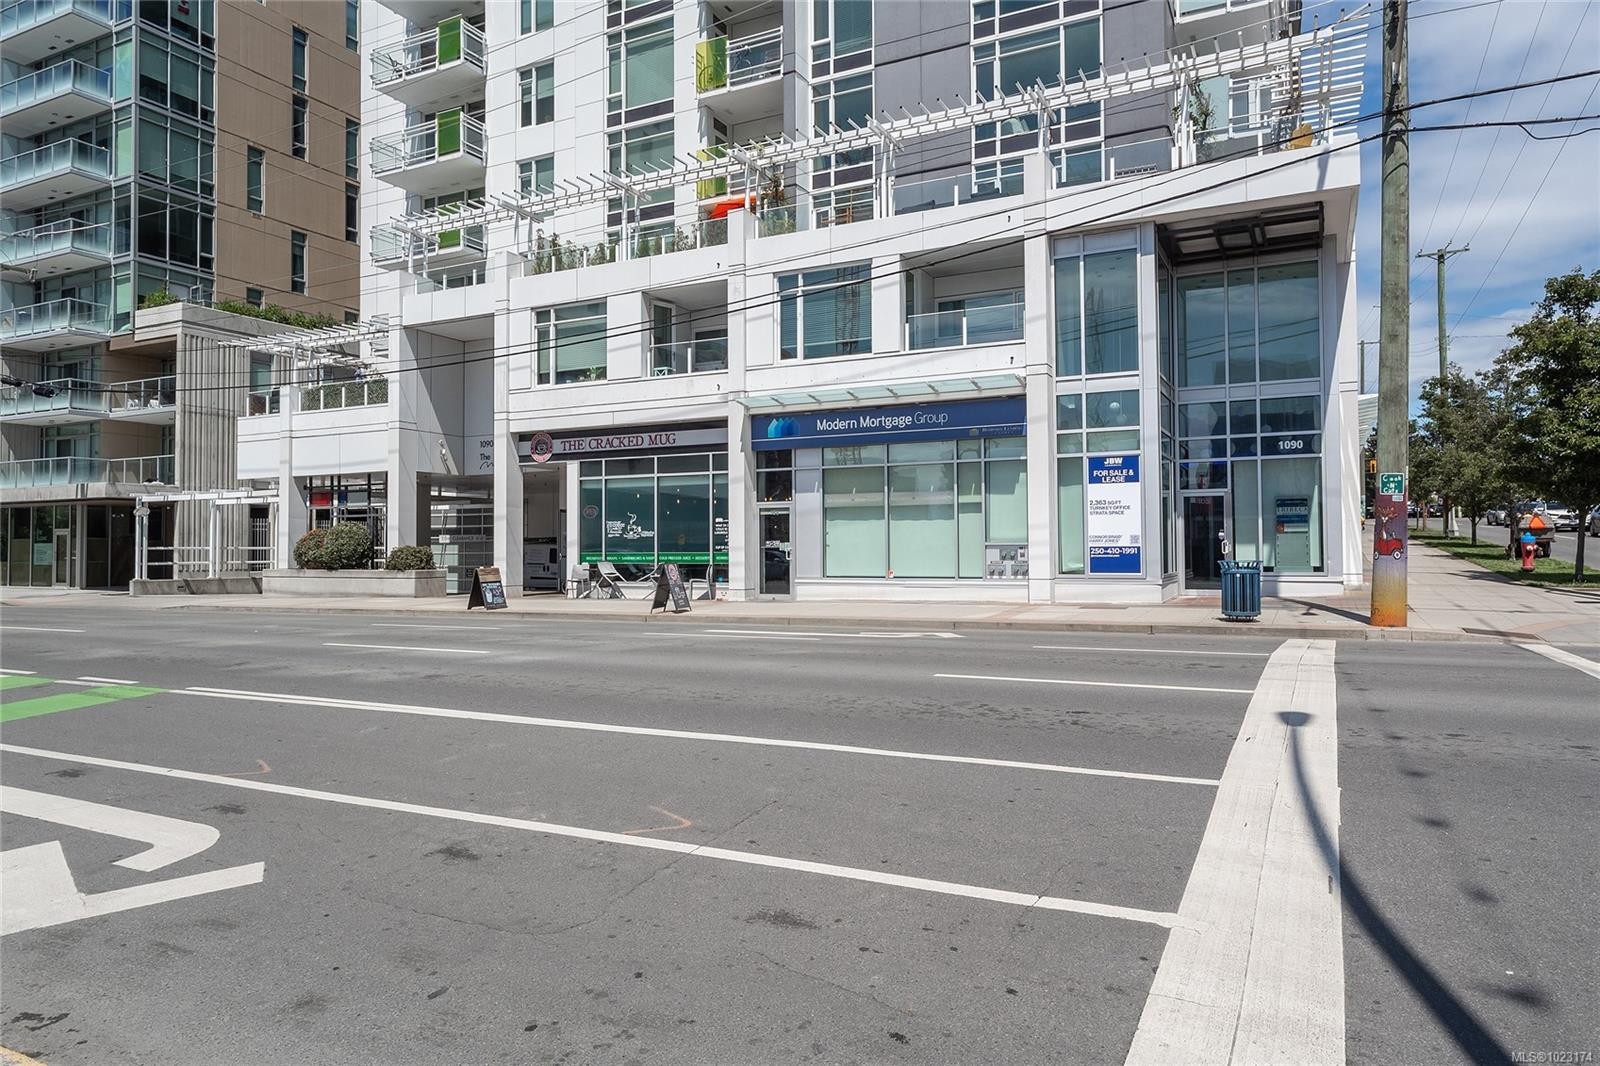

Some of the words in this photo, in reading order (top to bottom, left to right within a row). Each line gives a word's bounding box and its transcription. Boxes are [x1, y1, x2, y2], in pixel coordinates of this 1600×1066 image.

[816, 418, 857, 431] Modern
[860, 415, 913, 429] Mortgage
[914, 411, 948, 426] Group
[560, 440, 585, 451] THE
[588, 435, 644, 450] CRACKED
[648, 432, 676, 446] MUG
[1278, 440, 1304, 450] 1090
[479, 453, 491, 461] The
[1093, 469, 1109, 477] FOR
